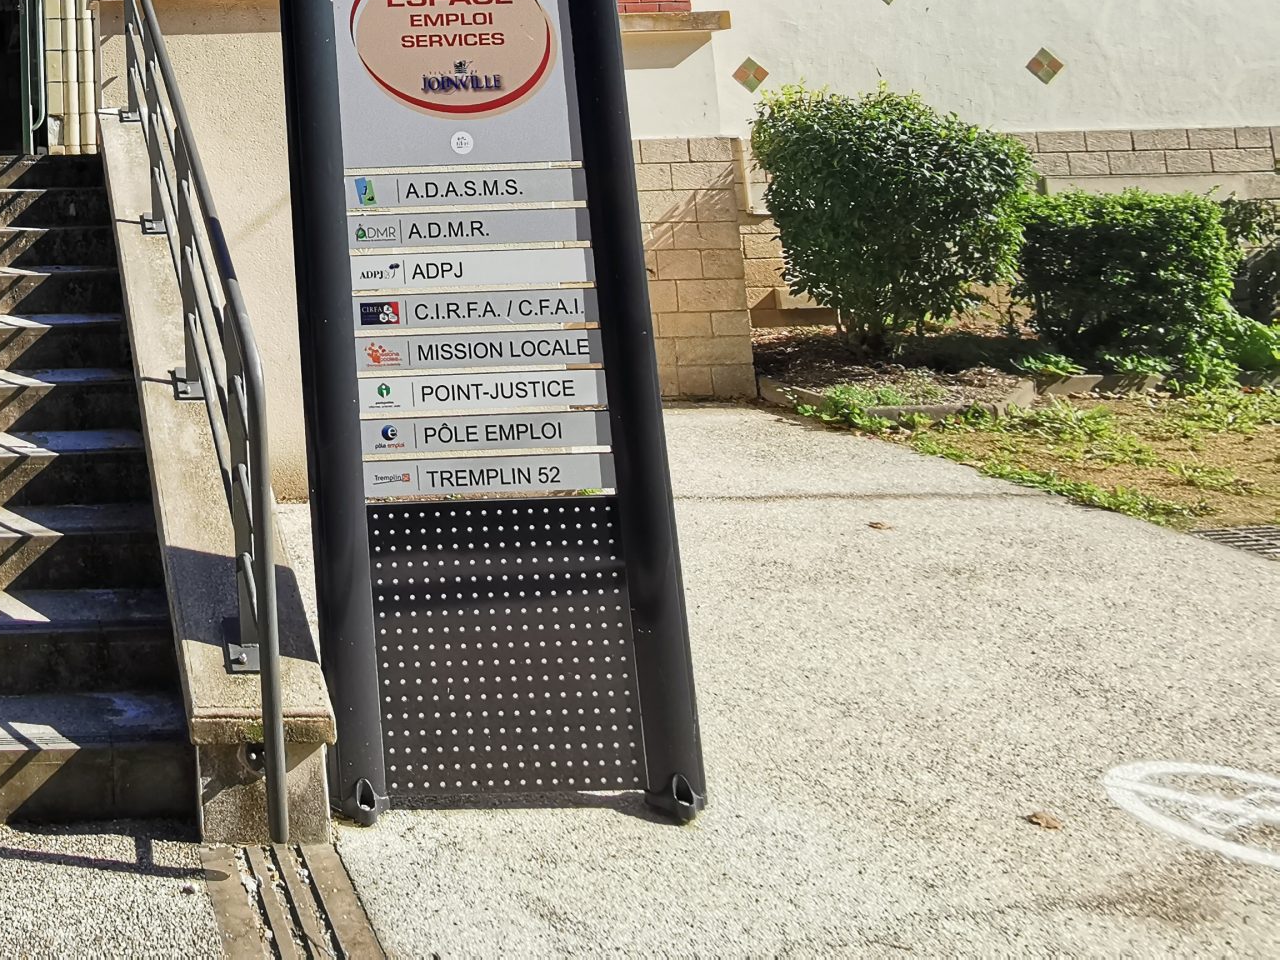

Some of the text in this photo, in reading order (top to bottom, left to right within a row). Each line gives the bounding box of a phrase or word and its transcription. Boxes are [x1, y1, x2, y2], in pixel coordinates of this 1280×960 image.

[409, 12, 494, 27] EMPLOI
[401, 32, 505, 48] SERVICES
[405, 178, 524, 199] A.D.A.S.M.S.
[408, 220, 490, 240] A.D.M.R.
[359, 270, 384, 280] ADPJ
[412, 261, 464, 280] ADPJ
[414, 298, 585, 320] C.I.R.F.A. / C.F.A.I.
[417, 338, 590, 361] MISSION LOCALE
[421, 379, 576, 403] POINT-JUSTICE
[424, 422, 562, 444] PÔLE EMPLOI
[374, 473, 402, 482] Tremplin
[426, 466, 561, 488] TREMPLIN 52
